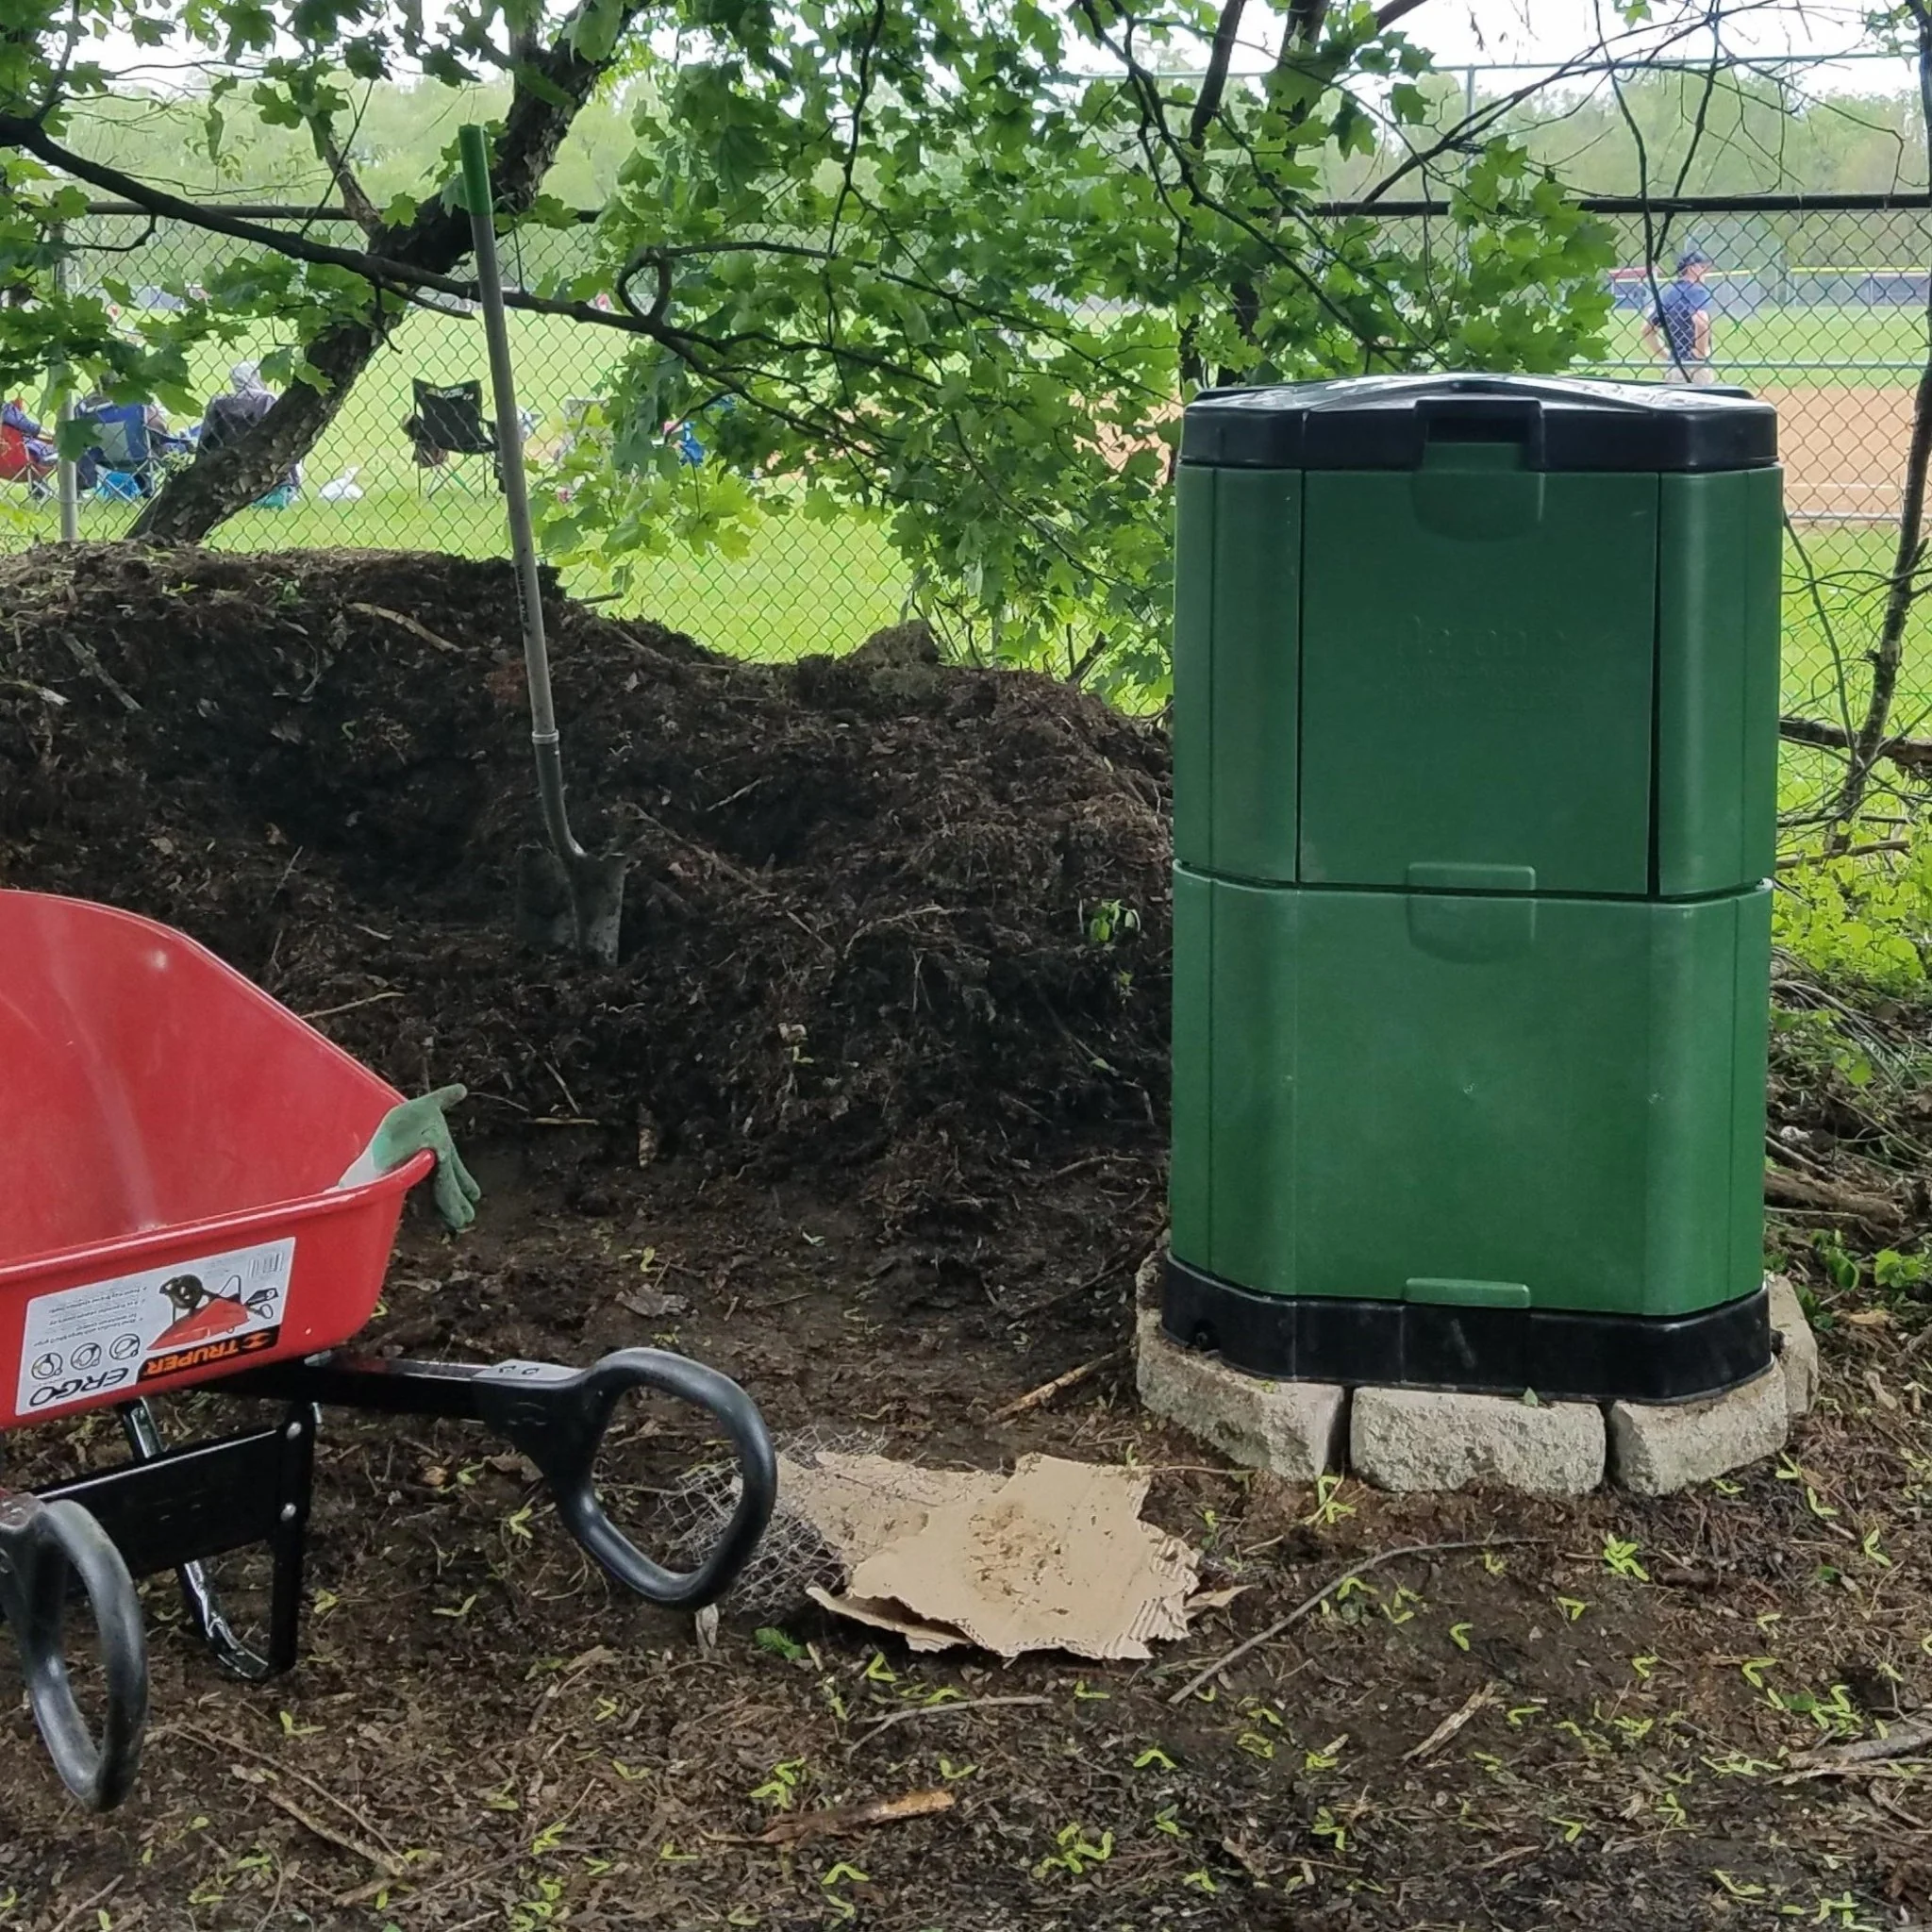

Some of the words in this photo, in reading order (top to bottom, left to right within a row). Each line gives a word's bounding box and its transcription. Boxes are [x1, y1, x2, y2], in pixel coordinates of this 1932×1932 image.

[266, 1290, 276, 1300] 6
[147, 1339, 239, 1375] TRUPER
[29, 1368, 128, 1407] ERGO
